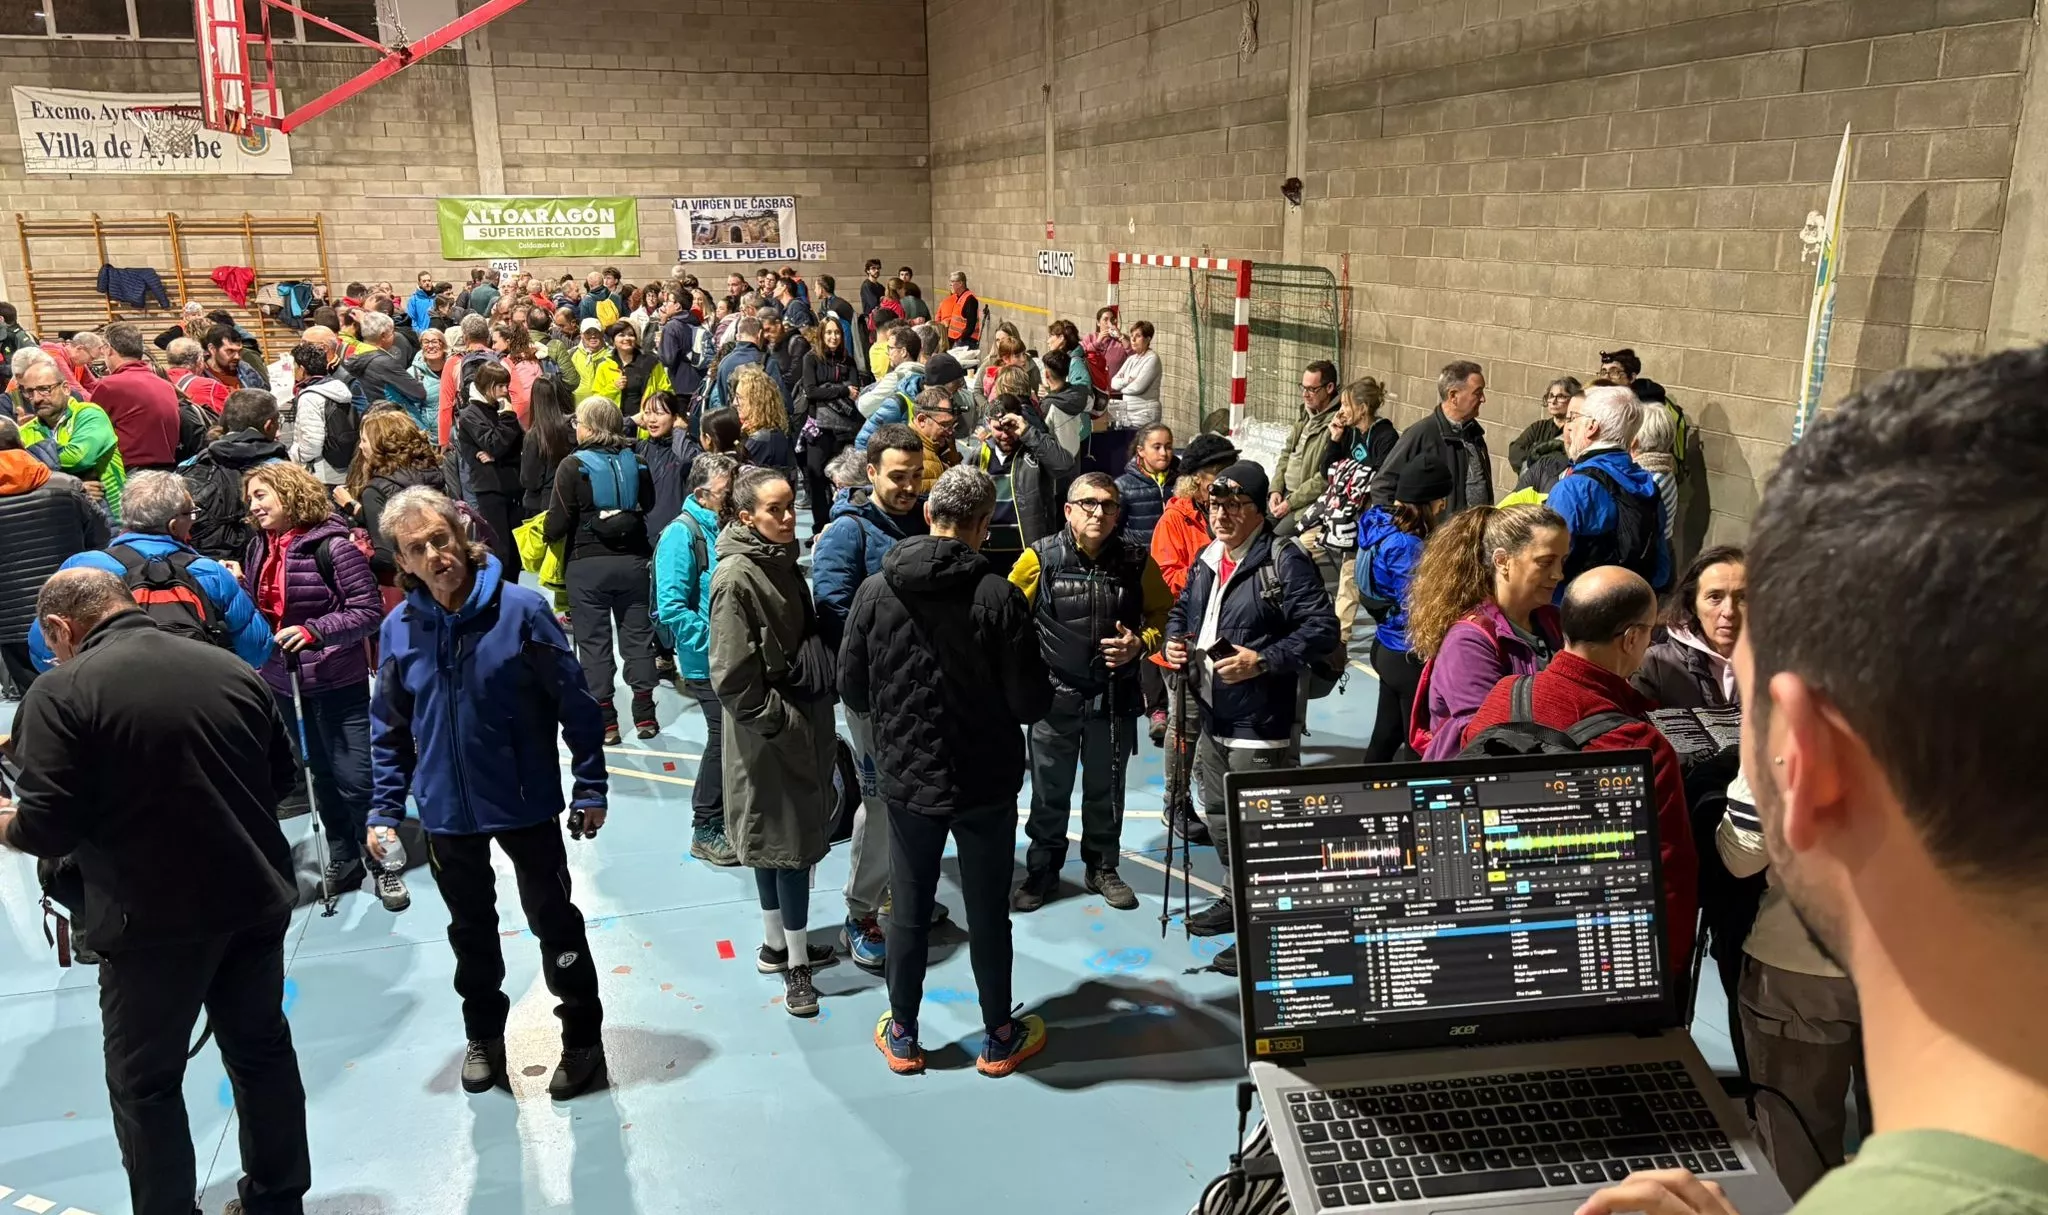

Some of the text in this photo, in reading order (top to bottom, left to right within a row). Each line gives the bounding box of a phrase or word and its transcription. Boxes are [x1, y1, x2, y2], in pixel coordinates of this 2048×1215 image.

[31, 101, 96, 120] Excmo.
[36, 132, 96, 158] Villa
[104, 134, 132, 158] de
[691, 200, 730, 209] VIRGEN
[734, 199, 748, 208] DE
[751, 198, 794, 208] CASBAS
[463, 206, 614, 224] ALTOARAGÓN
[480, 226, 600, 238] SUPERMERCADOS
[802, 243, 824, 252] CAFES
[679, 248, 796, 260] ES DEL PUEBLO
[492, 262, 518, 271] CAFES
[1038, 252, 1073, 276] CELIACOS
[1636, 800, 1641, 808] B
[1402, 815, 1409, 823] A
[1449, 1024, 1480, 1035] acer
[1336, 1125, 1344, 1133] Q
